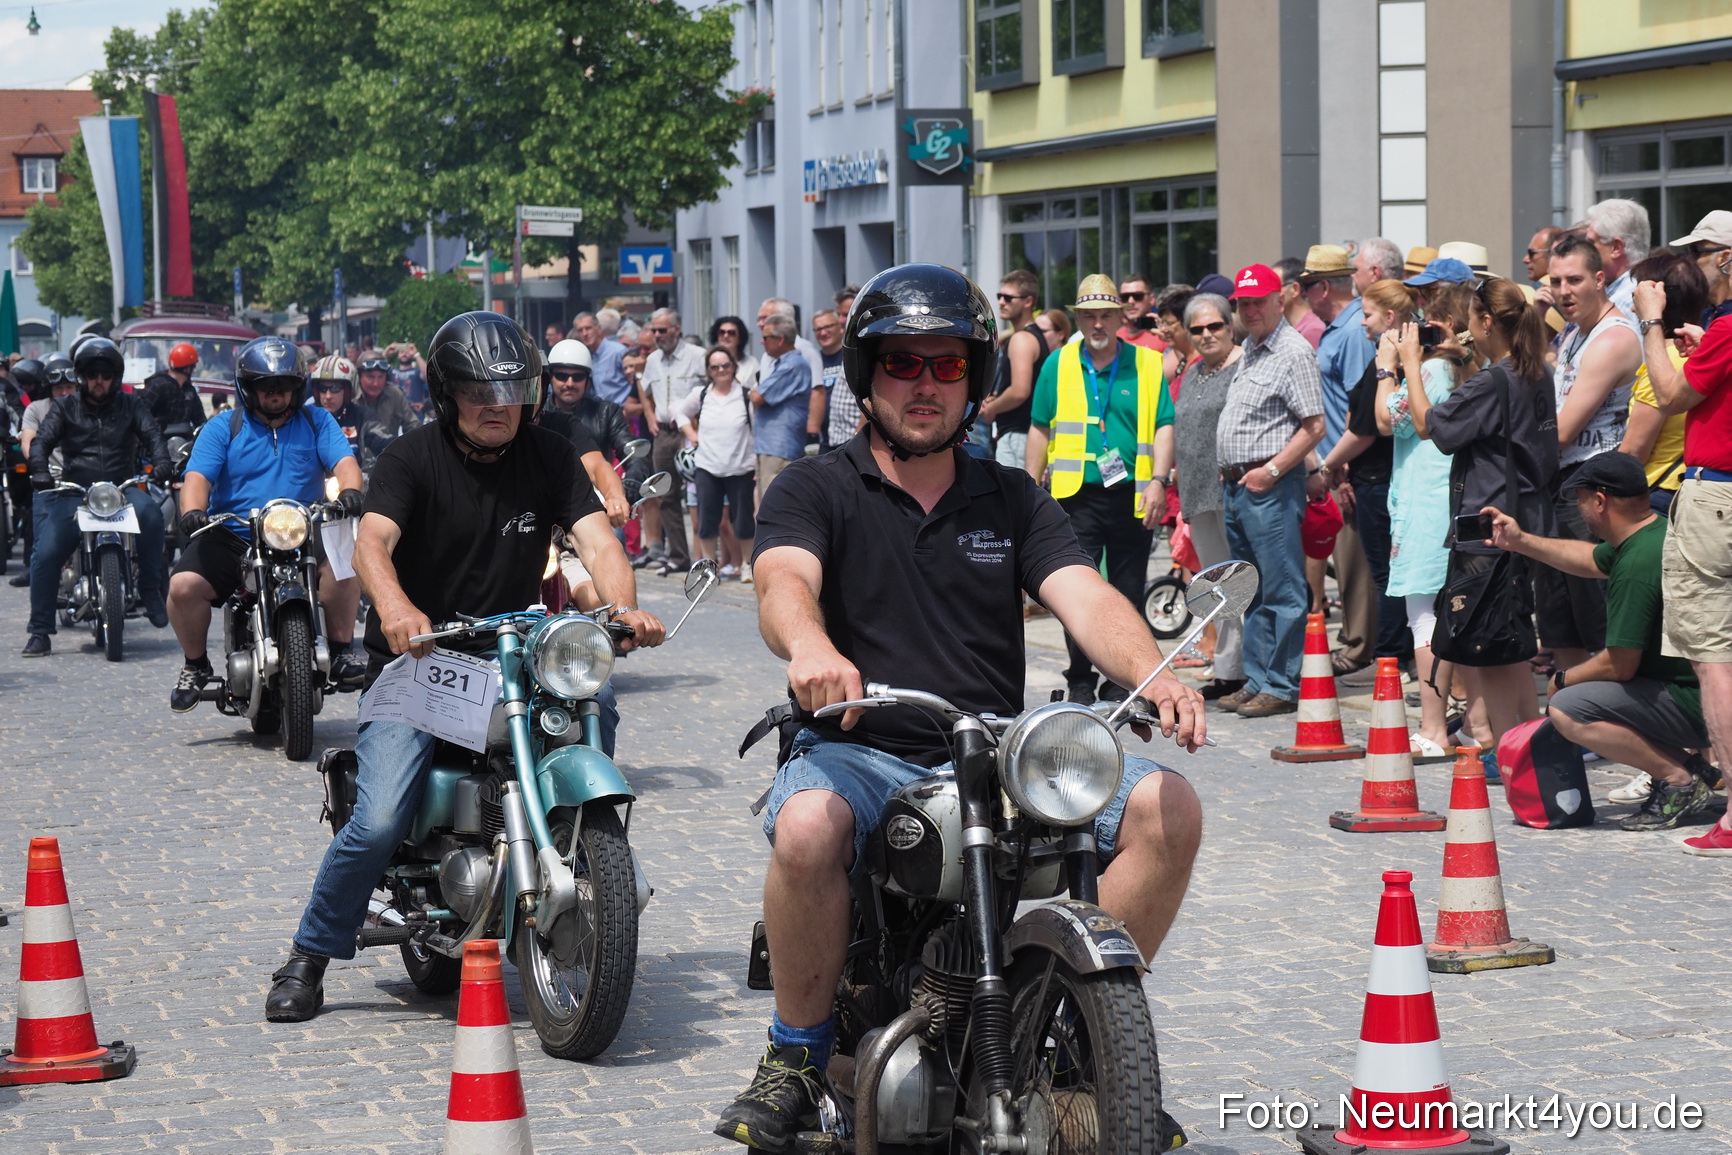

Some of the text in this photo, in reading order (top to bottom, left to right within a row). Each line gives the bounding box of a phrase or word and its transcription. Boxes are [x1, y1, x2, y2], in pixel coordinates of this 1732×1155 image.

[925, 129, 953, 161] G2
[497, 363, 518, 371] uvex
[427, 665, 470, 692] 321
